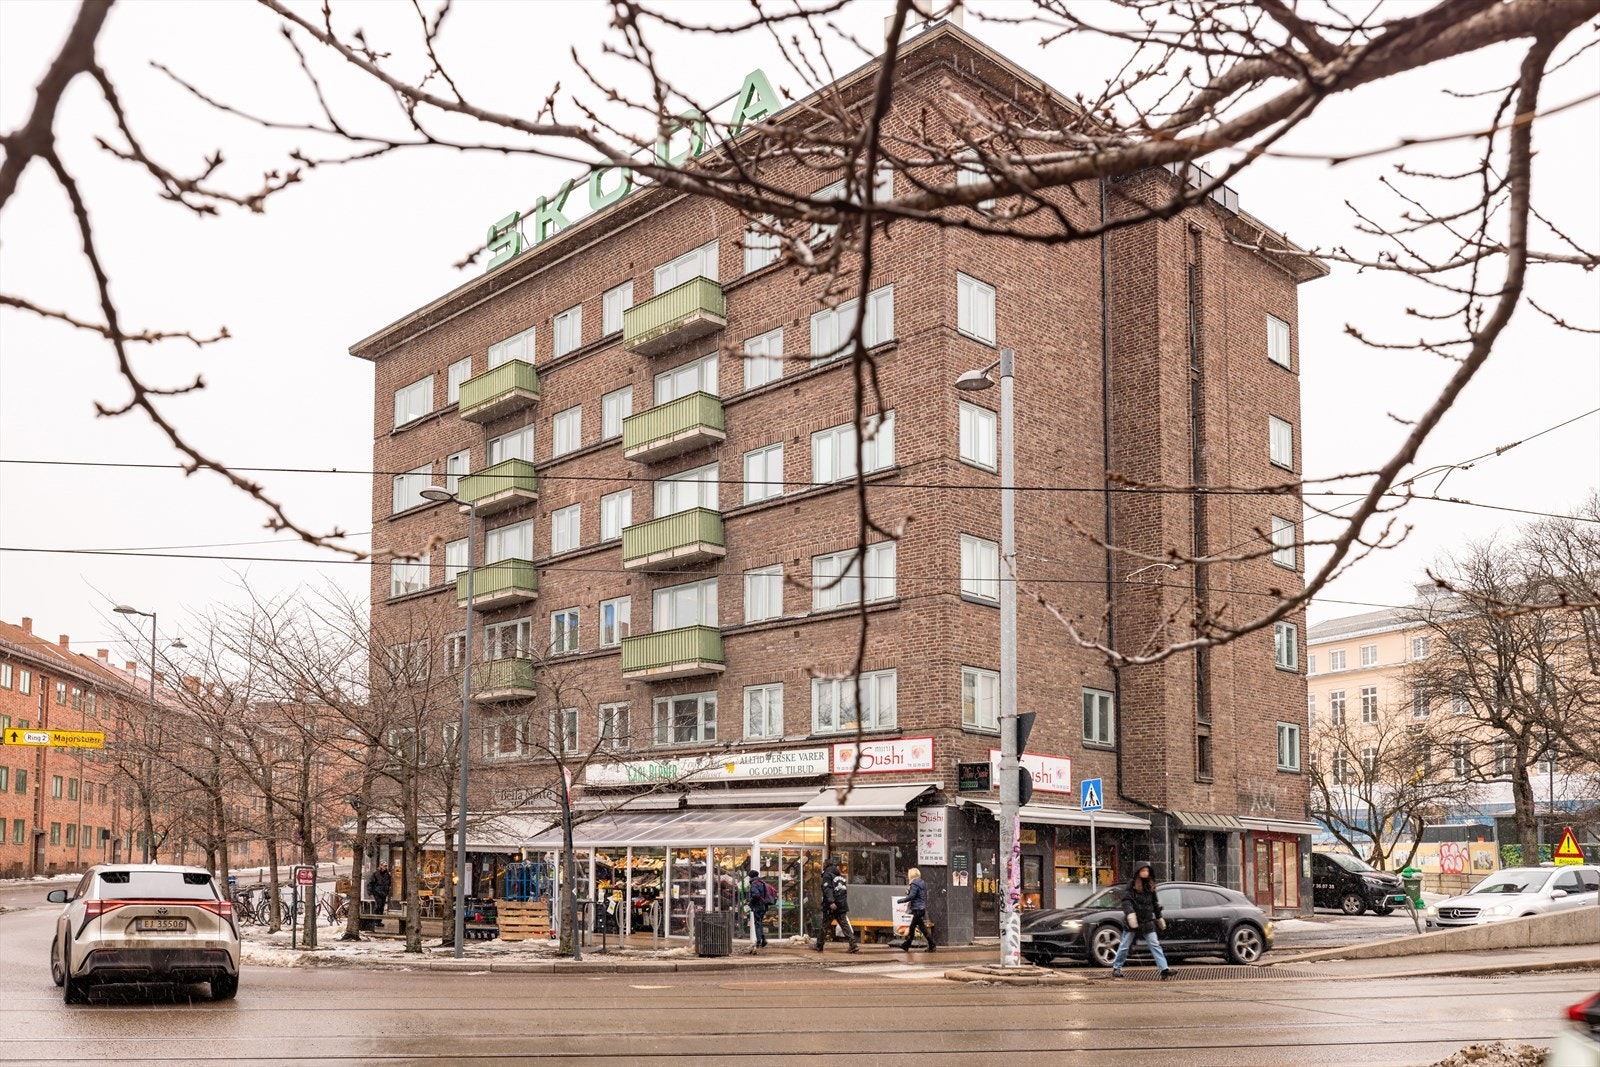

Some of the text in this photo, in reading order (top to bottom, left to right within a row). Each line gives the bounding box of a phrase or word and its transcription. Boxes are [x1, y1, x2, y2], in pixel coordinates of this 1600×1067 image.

[486, 68, 783, 273] SKODA
[54, 734, 100, 744] Majorstuen
[740, 755, 765, 765] ALLTID
[799, 751, 825, 761] VARER
[859, 745, 904, 769] Sushi
[649, 764, 678, 780] BERNER
[749, 764, 814, 776] OG GODE TILBUD
[1021, 760, 1053, 784] ushi
[501, 789, 523, 800] Bella
[919, 811, 944, 824] Sushi
[144, 920, 184, 928] EJ 35506
